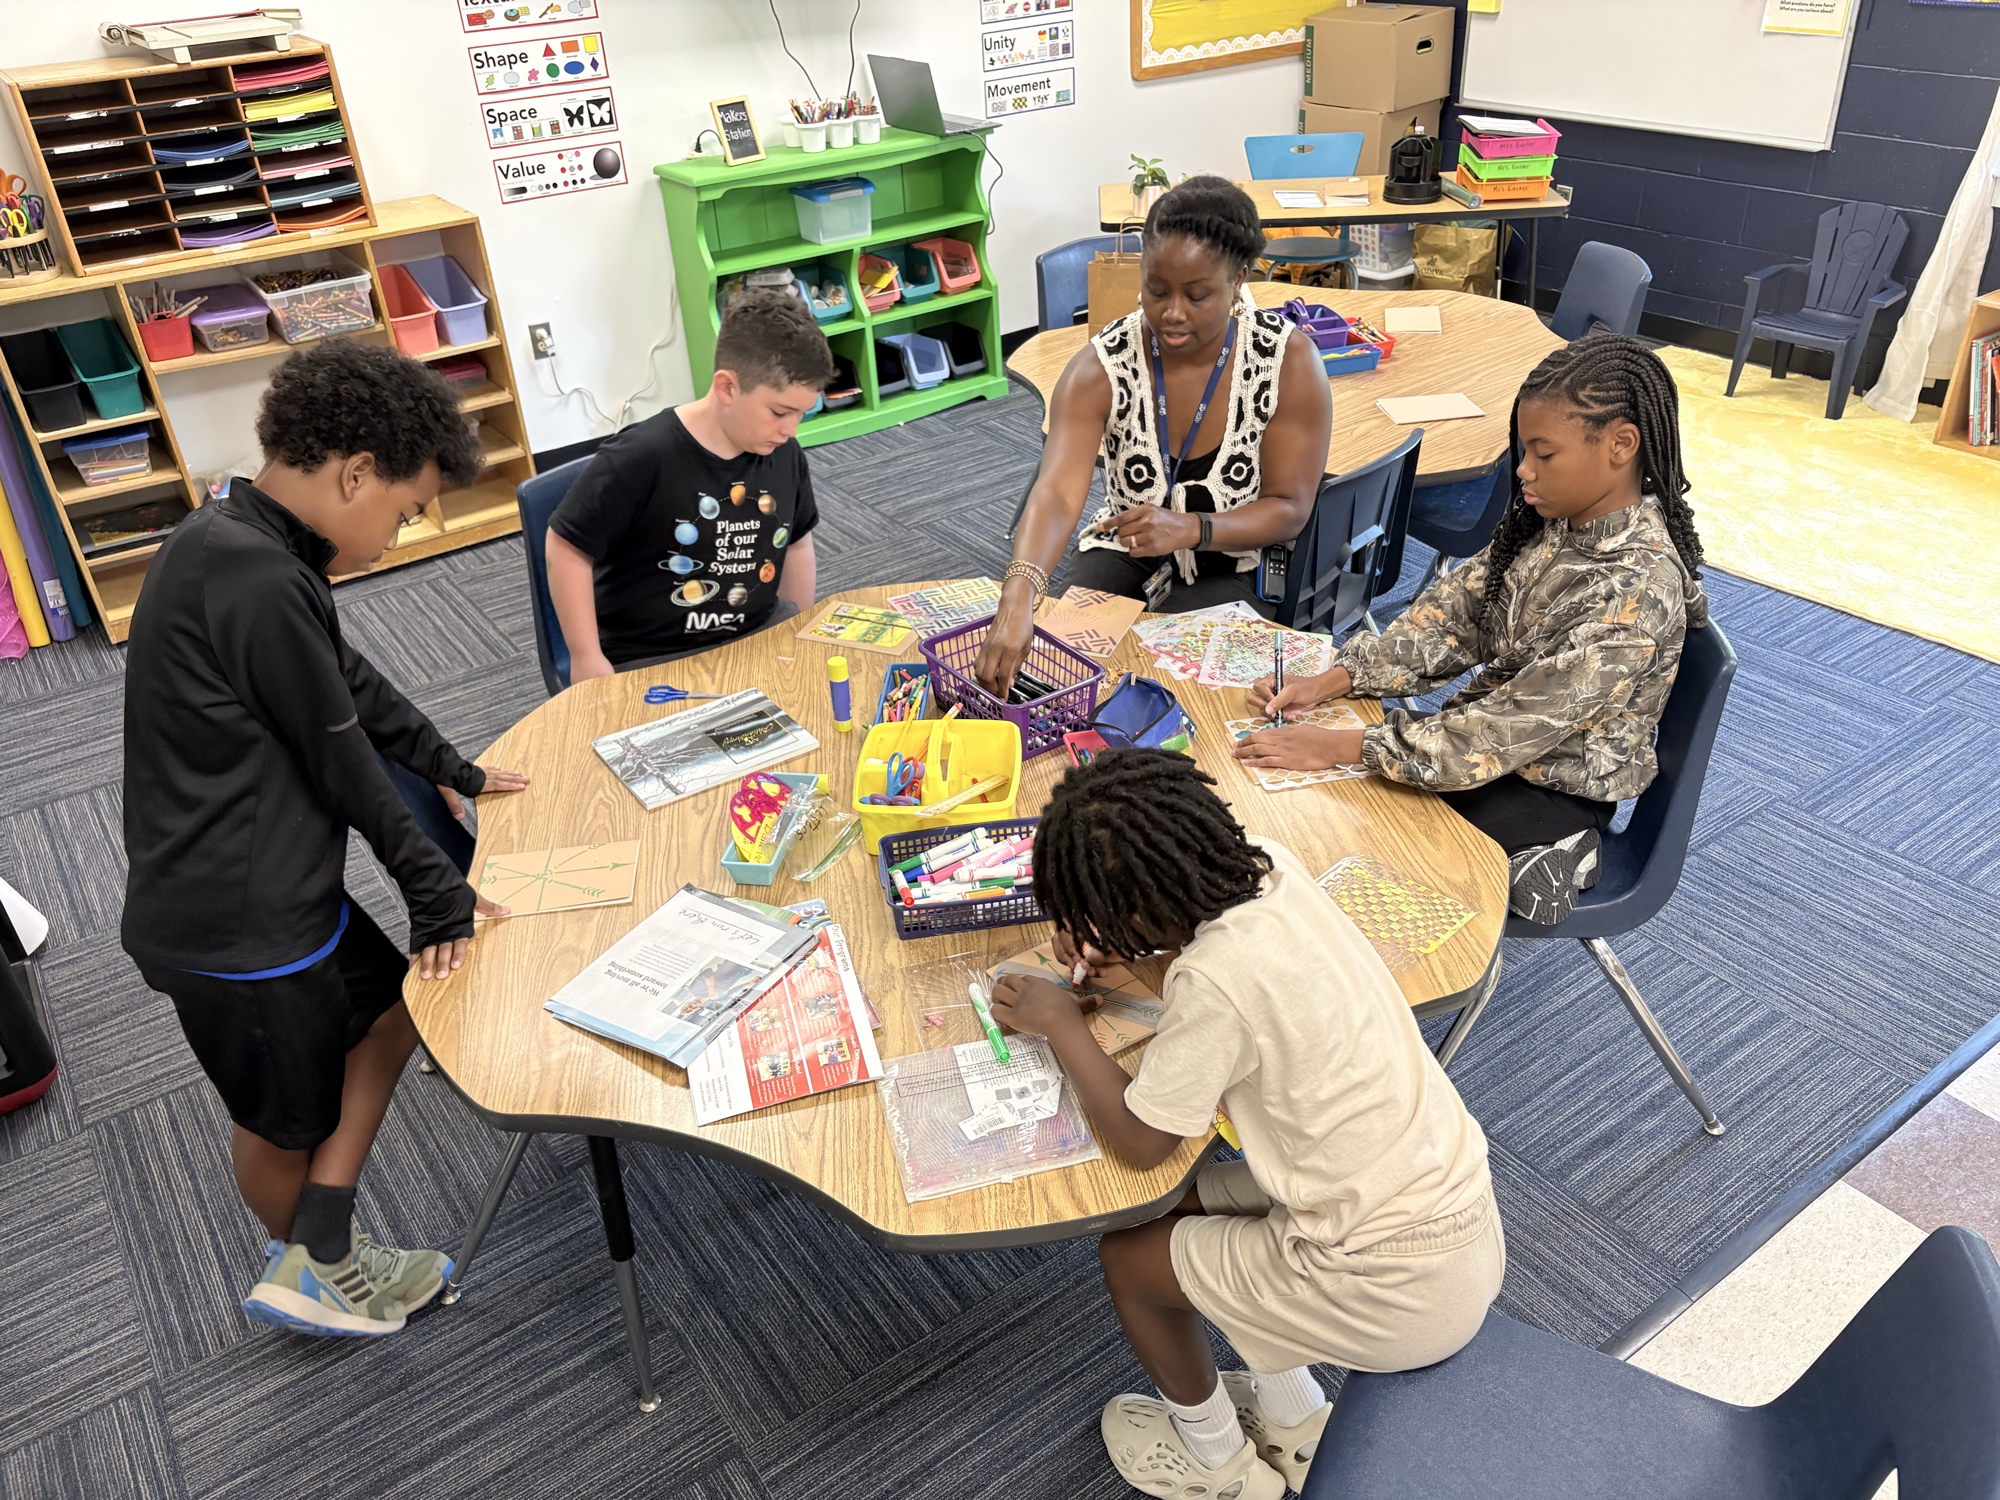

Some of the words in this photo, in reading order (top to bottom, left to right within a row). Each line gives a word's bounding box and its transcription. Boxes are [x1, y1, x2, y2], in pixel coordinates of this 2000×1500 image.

[984, 35, 1016, 52] Unity
[473, 51, 529, 70] Shape
[988, 78, 1051, 98] Movement
[486, 107, 538, 128] Space
[725, 128, 753, 141] Station
[498, 161, 546, 179] Value
[716, 520, 761, 533] Planets
[715, 533, 731, 547] of
[734, 534, 758, 545] our
[717, 547, 754, 561] Solar
[708, 562, 757, 576] System
[678, 908, 704, 925] there
[728, 930, 760, 945] Let's
[832, 925, 840, 938] Our
[835, 940, 850, 972] Programs
[603, 969, 631, 983] moving
[607, 960, 644, 978] something
[641, 975, 668, 989] toward
[640, 984, 660, 996] We're
